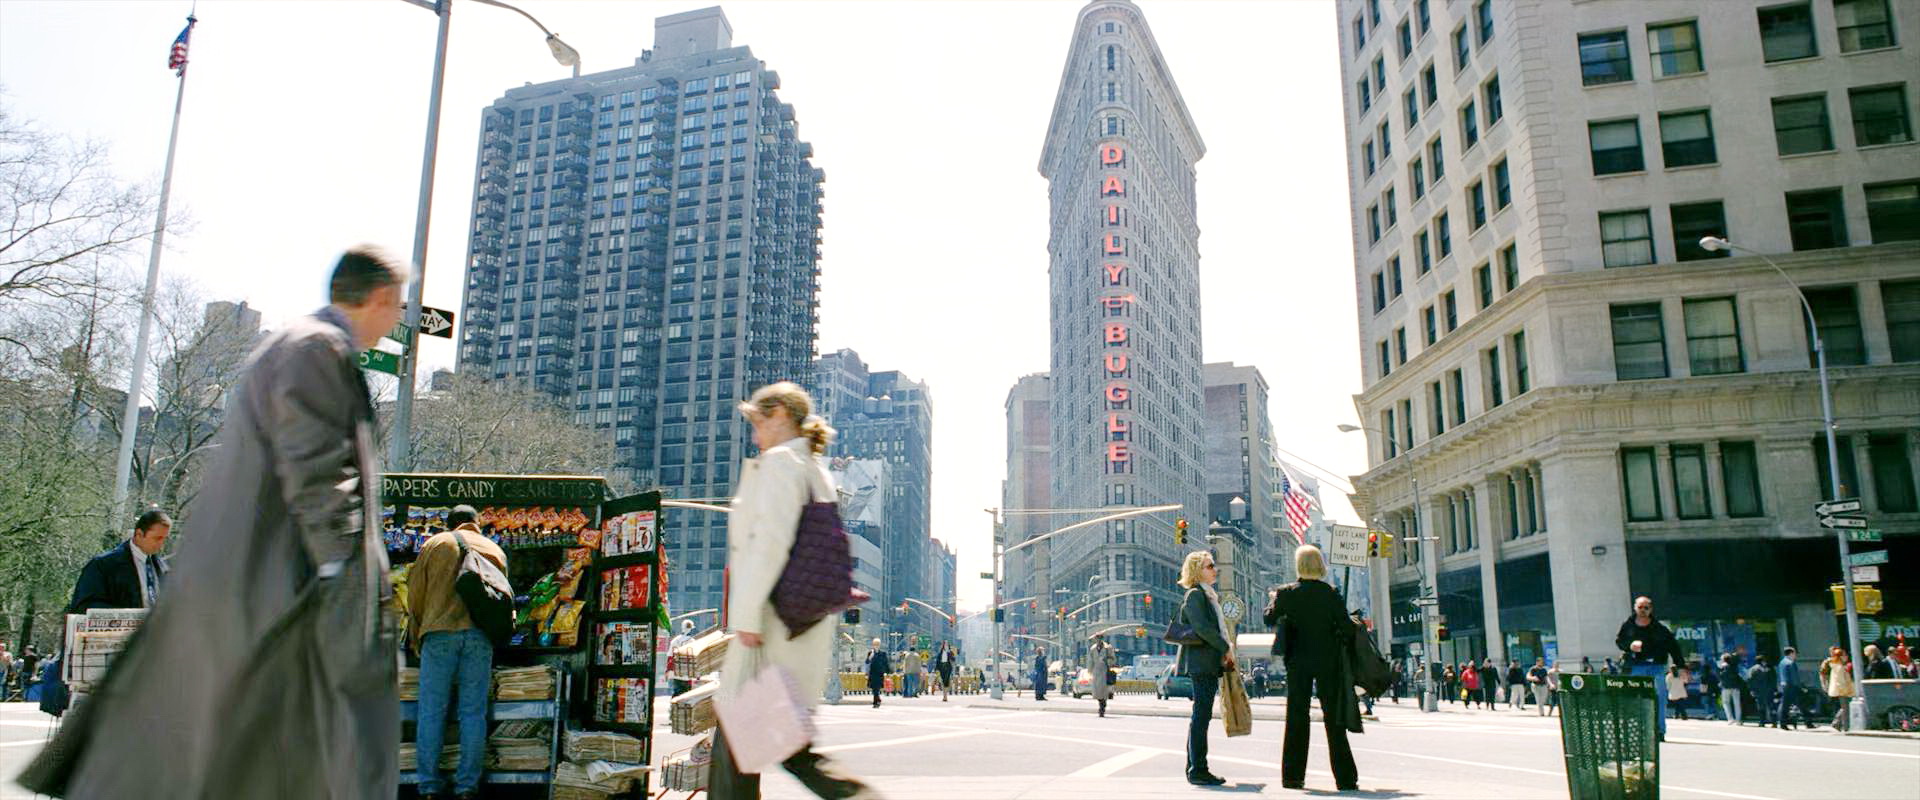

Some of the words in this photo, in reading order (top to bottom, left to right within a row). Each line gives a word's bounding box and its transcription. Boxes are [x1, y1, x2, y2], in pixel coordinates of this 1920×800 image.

[1102, 146, 1125, 285] DAILY
[420, 313, 443, 328] WAY
[1105, 324, 1129, 462] BUGLE
[384, 478, 440, 498] PAPERS
[447, 479, 498, 498] CANDY
[1340, 541, 1360, 551] MUST
[1333, 552, 1348, 561] TURN
[1675, 627, 1708, 640] AT&T
[1885, 624, 1920, 638] AT&T
[1606, 679, 1624, 689] Keep
